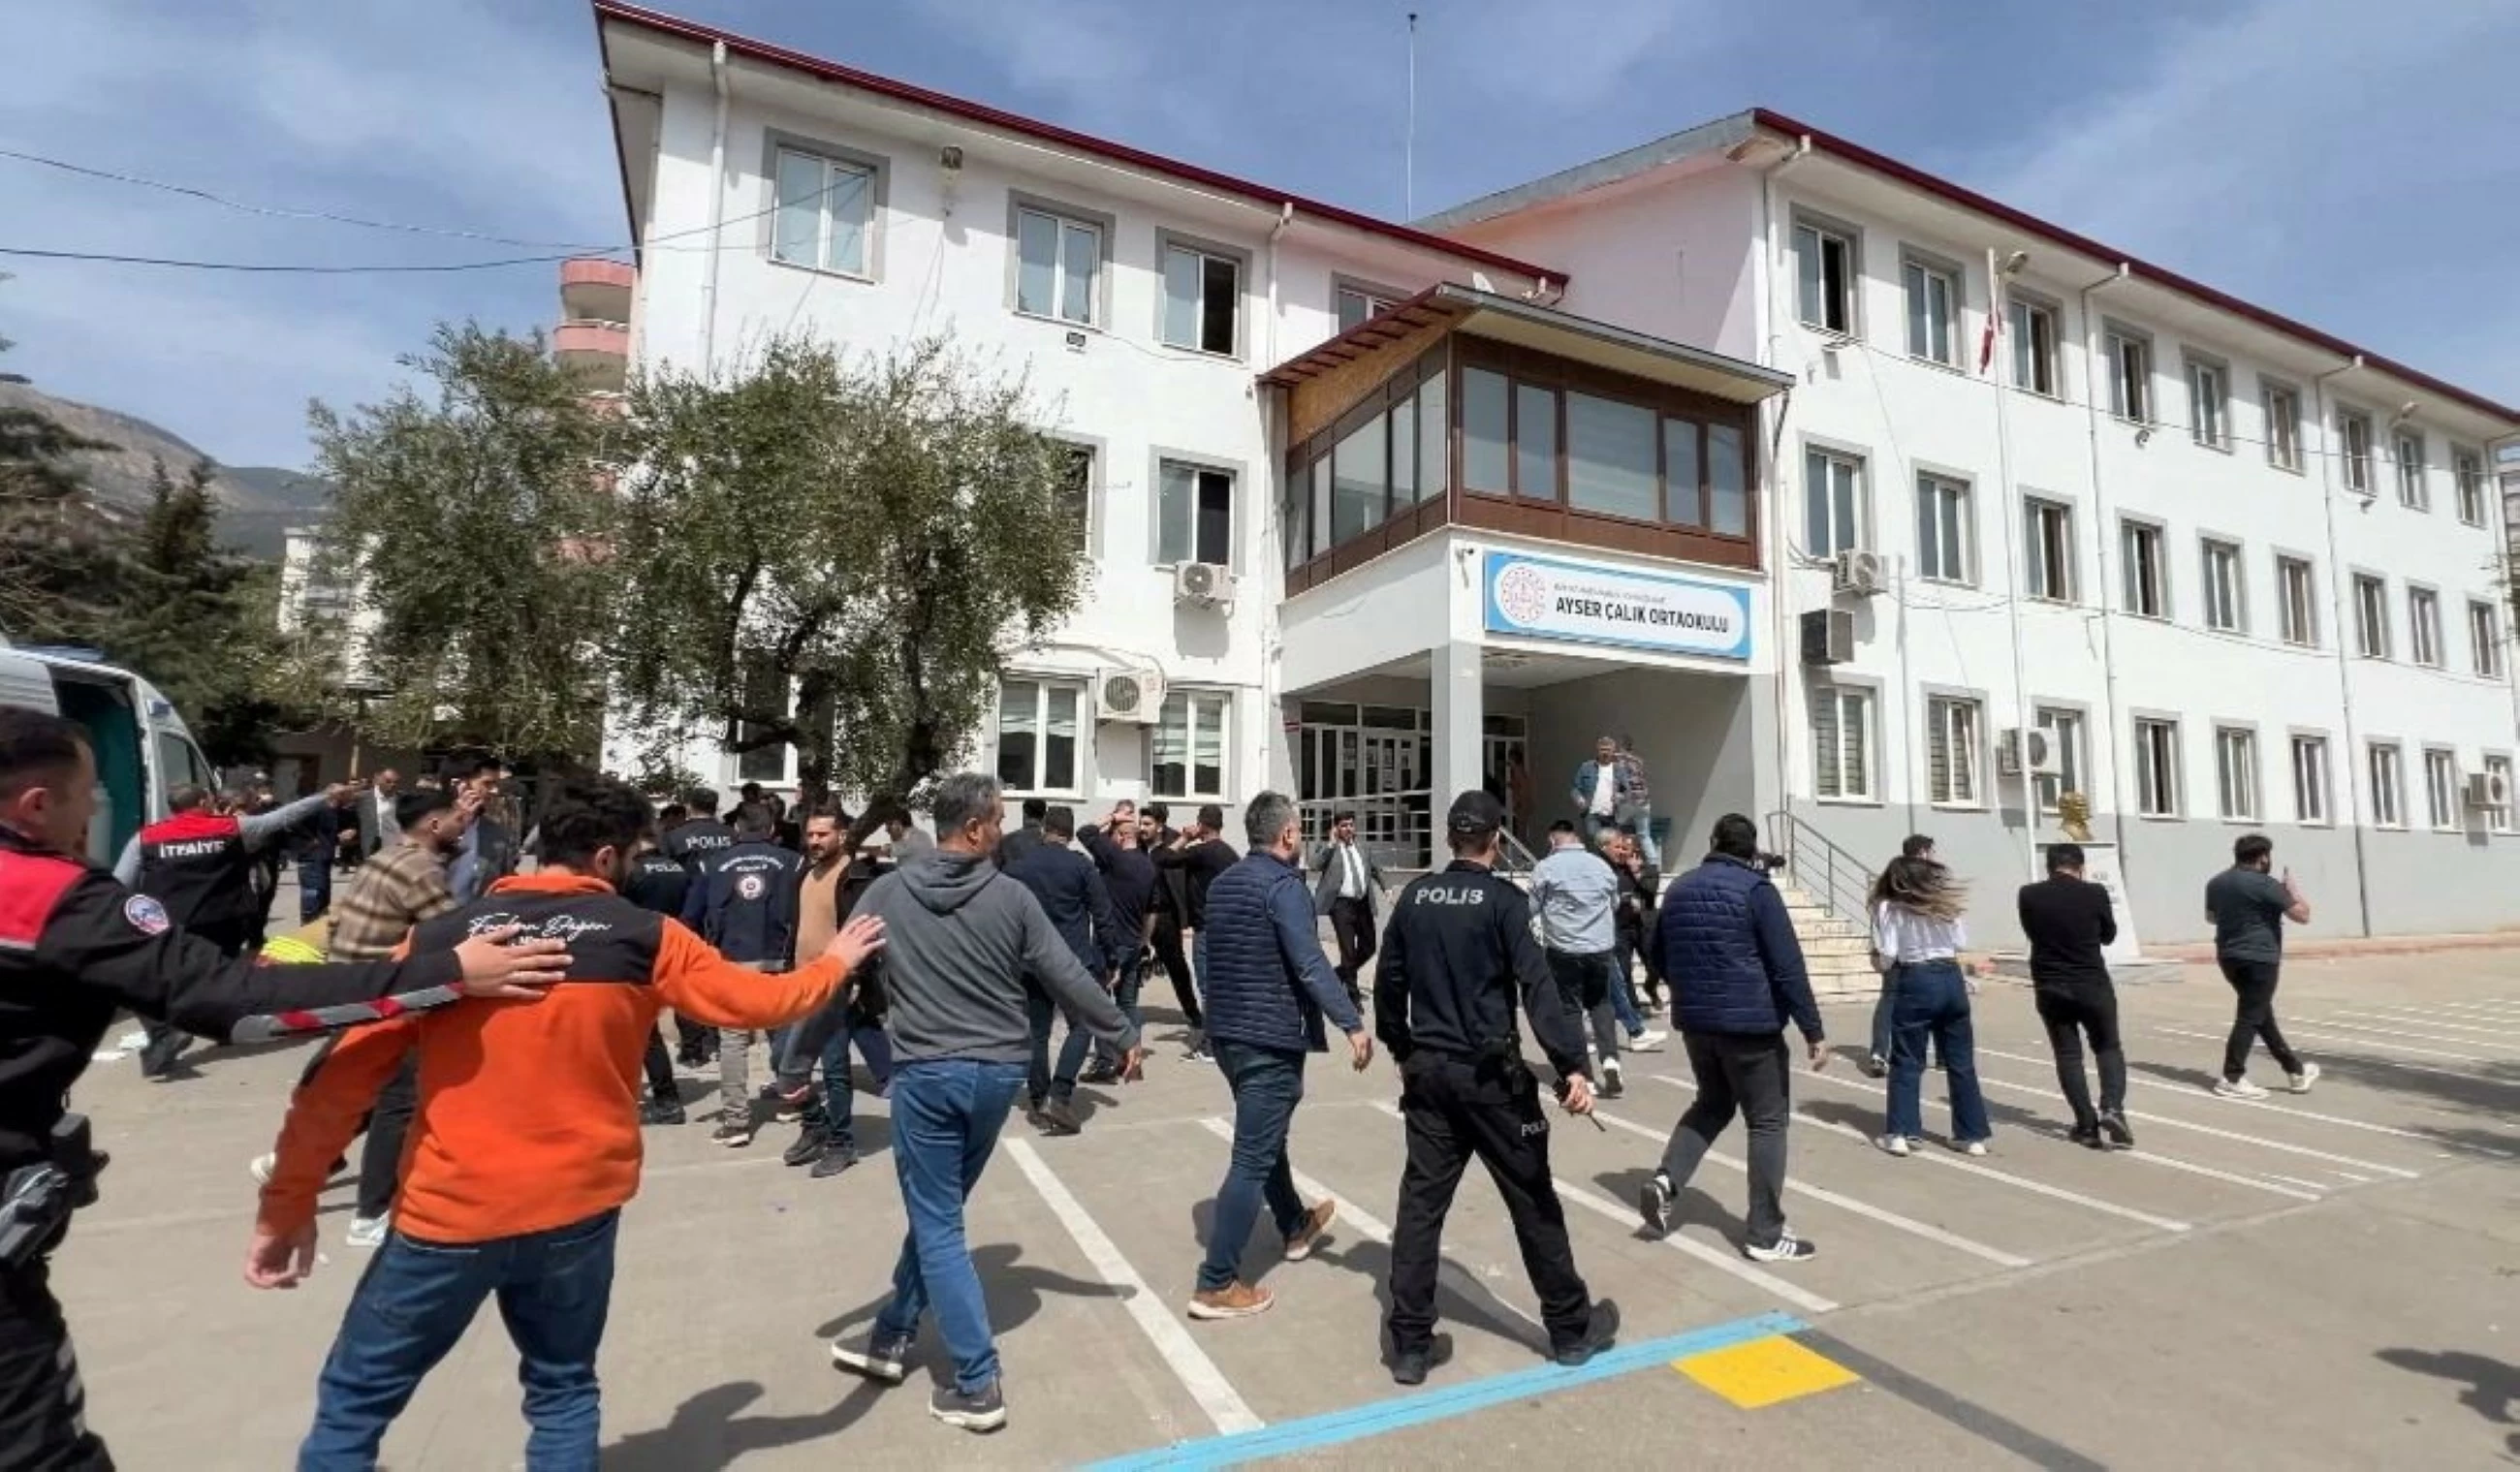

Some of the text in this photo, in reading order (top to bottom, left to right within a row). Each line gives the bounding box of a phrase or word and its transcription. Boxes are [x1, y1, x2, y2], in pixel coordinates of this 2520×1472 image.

[1556, 596, 1728, 633] AYSER ÇALIK ORTAOKULU
